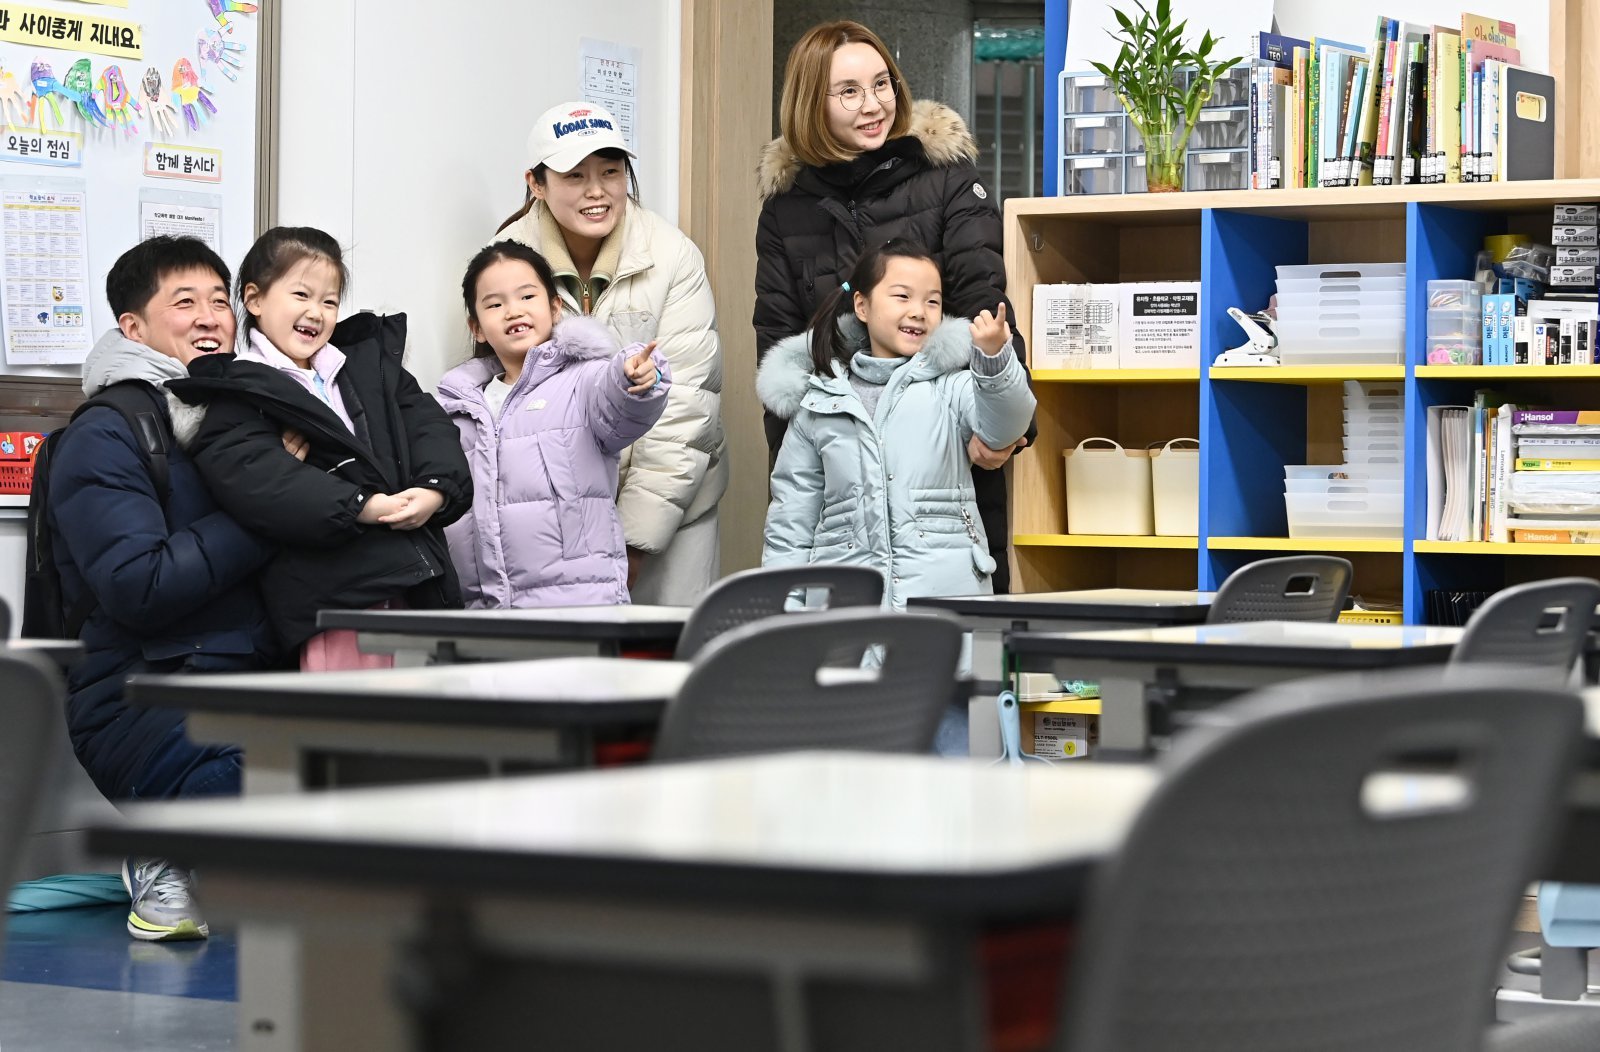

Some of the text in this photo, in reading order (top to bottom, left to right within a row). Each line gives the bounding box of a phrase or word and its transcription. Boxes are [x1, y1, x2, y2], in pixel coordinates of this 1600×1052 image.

[19, 12, 84, 41] 사이좋게
[90, 23, 141, 49] 지내요.
[1268, 50, 1281, 61] TEO
[552, 118, 589, 139] KODAK
[7, 135, 70, 160] 오늘의 점심
[155, 152, 215, 173] 함께 봅시다
[1556, 215, 1572, 223] 지우개
[1554, 235, 1570, 243] 지우개
[1558, 256, 1573, 264] 지우개
[1552, 275, 1569, 283] 지우개
[1524, 412, 1553, 421] Hansol
[1528, 532, 1557, 541] Hansol
